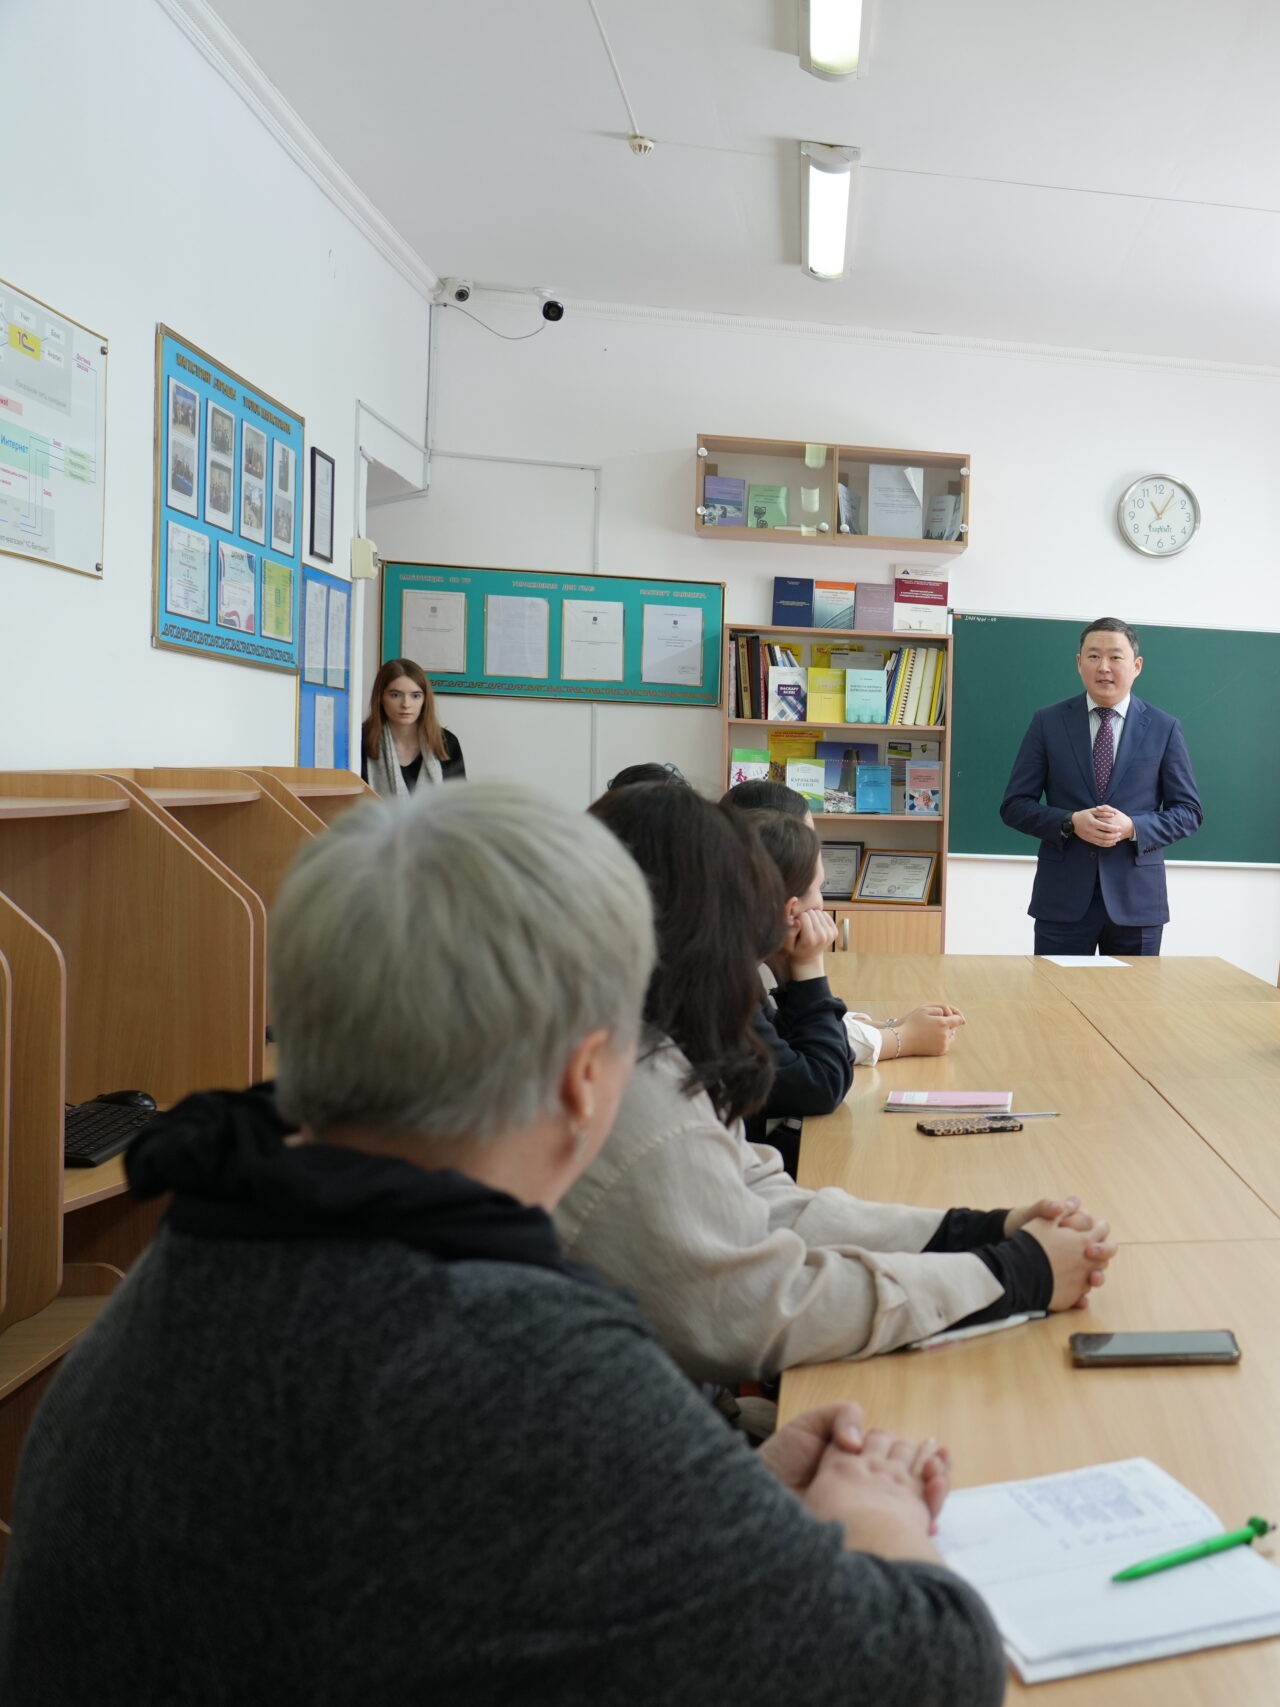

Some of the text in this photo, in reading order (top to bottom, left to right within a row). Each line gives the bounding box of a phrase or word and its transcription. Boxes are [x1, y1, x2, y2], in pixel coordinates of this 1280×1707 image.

[0, 433, 29, 455] Интернет
[1142, 488, 1150, 498] 11
[1153, 484, 1165, 495] 12
[1132, 498, 1145, 509] 10
[1180, 499, 1187, 510] 2
[1128, 510, 1136, 521] 9
[1184, 512, 1191, 523] 3
[1132, 523, 1140, 534] 8
[1180, 526, 1187, 535] 4
[1143, 534, 1150, 544] 7
[1156, 538, 1164, 549] 6
[1170, 534, 1177, 545] 5
